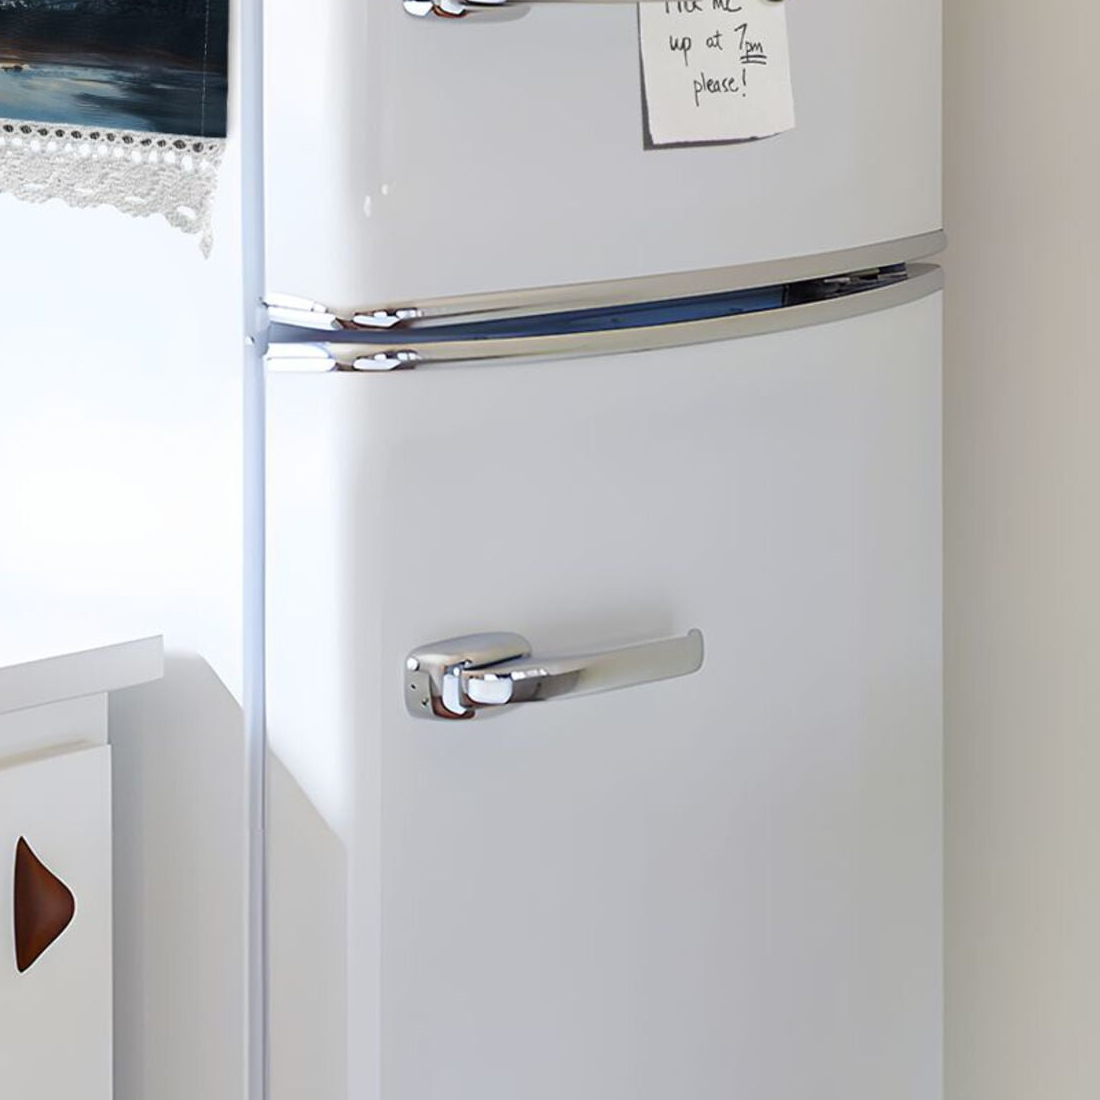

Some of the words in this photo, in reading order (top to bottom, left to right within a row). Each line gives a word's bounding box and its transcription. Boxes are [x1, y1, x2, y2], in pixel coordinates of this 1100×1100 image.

[669, 35, 692, 66] up
[706, 30, 723, 50] at
[693, 68, 747, 107] please!
